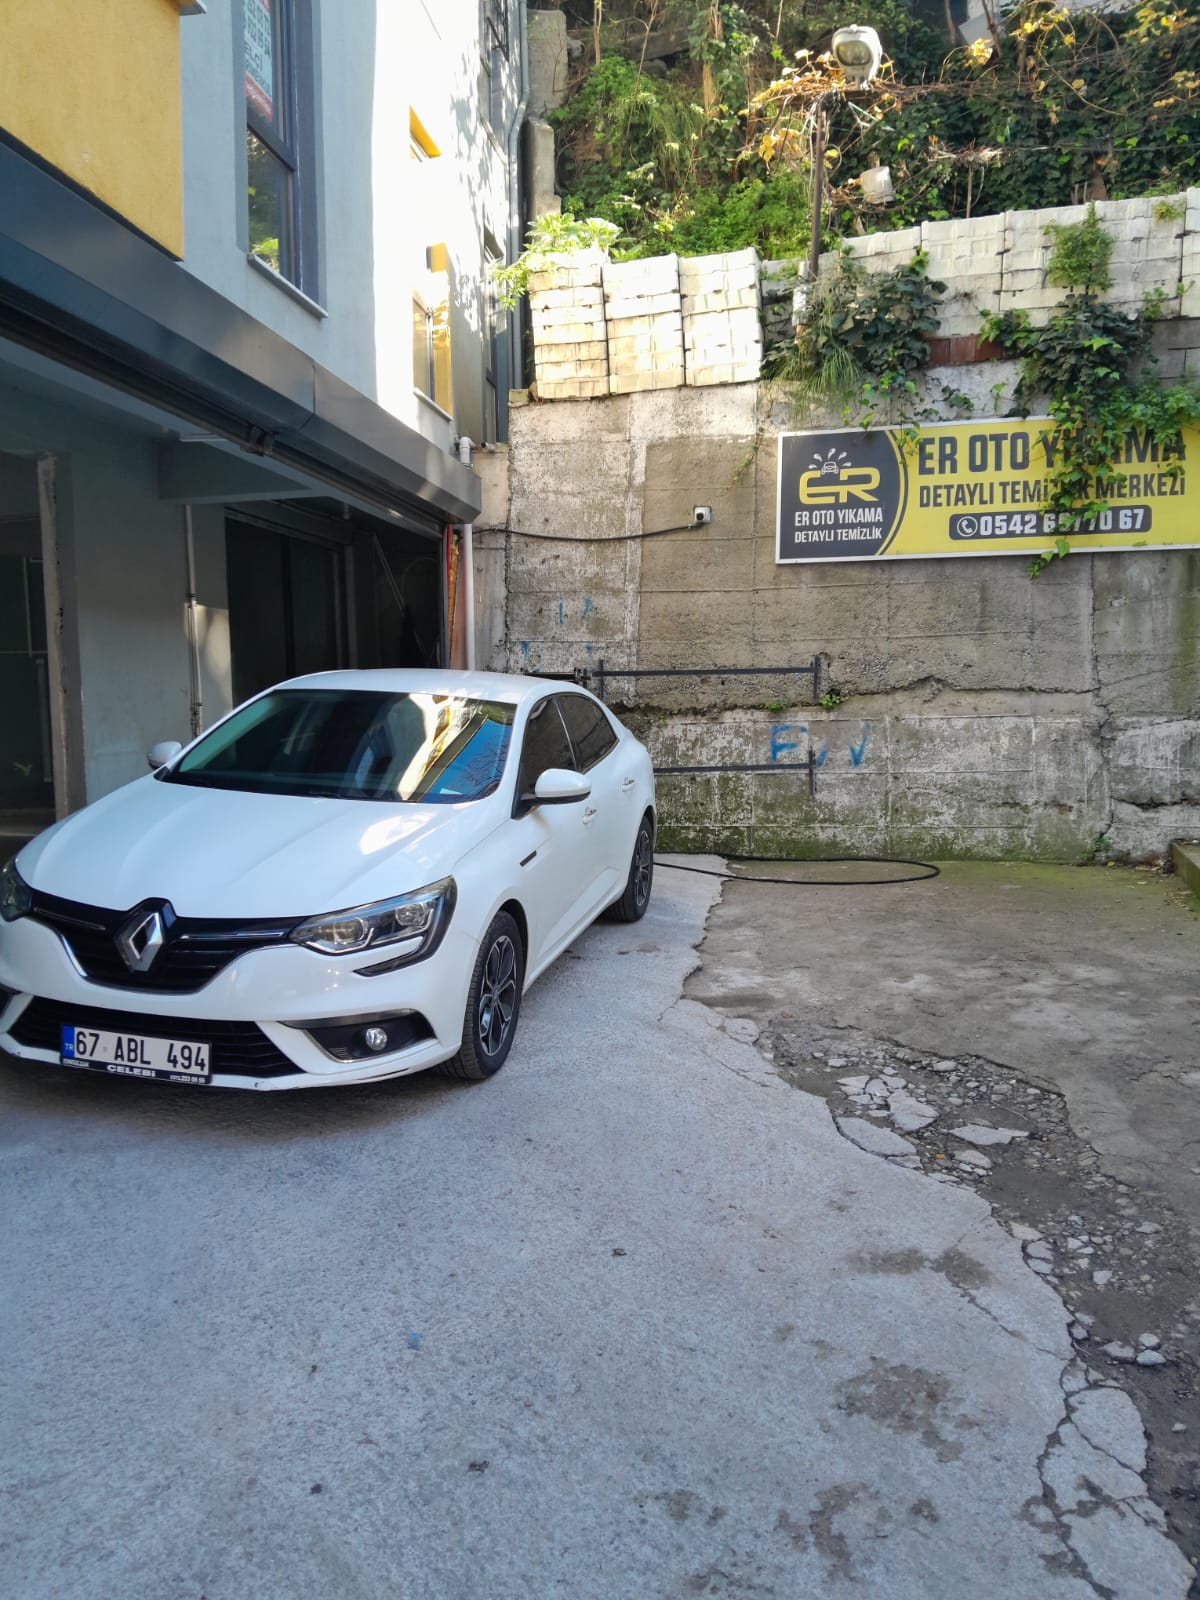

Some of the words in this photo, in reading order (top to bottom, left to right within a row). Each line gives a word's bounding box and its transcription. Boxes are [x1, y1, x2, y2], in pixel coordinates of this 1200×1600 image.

[918, 436, 958, 475] ER
[968, 432, 1030, 472] OTO
[799, 467, 880, 505] ER
[919, 482, 994, 508] DETAYLI
[999, 475, 1090, 505] TEMİK
[795, 511, 810, 526] ER
[812, 510, 835, 525] OTO
[837, 507, 883, 524] YIKAMA
[980, 513, 1037, 536] 0542
[1119, 508, 1144, 530] 67
[795, 529, 834, 543] DETAYLI
[836, 525, 882, 541] TEMİZLİK
[64, 1043, 74, 1051] TR
[76, 1031, 100, 1057] 67
[114, 1037, 151, 1065] ABL
[167, 1043, 206, 1071] 494
